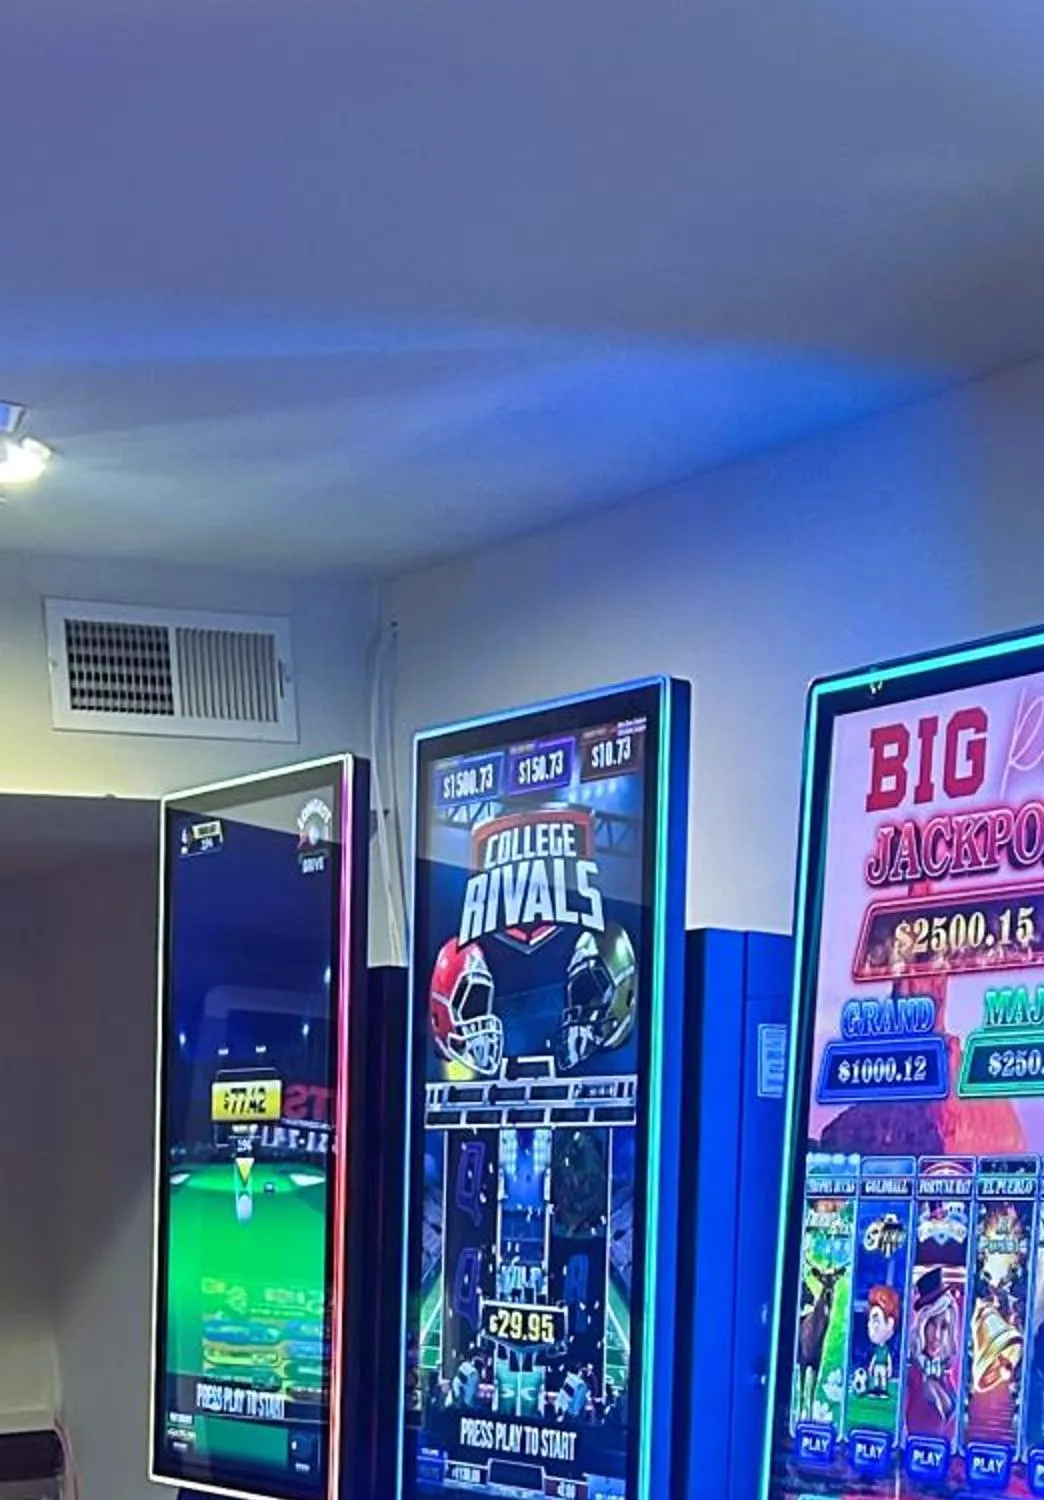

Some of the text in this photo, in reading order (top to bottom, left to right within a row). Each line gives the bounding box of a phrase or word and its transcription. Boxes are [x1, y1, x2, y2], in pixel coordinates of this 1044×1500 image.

[519, 750, 564, 785] $150.73
[591, 735, 632, 769] $10.73
[866, 706, 989, 812] BIG
[484, 822, 578, 869] COLLEGE
[458, 857, 606, 946] RIVALS
[893, 906, 1037, 957] $2500.15
[842, 998, 937, 1039] GRAND
[837, 1055, 928, 1086] $1000.12
[196, 1383, 223, 1413] PRESS
[223, 1386, 245, 1415] PLAY
[258, 1391, 286, 1420] START
[459, 1416, 578, 1462] PRESS PLAY TO START
[802, 1437, 829, 1453] PLAY
[855, 1443, 884, 1460] PLAY
[912, 1449, 943, 1467] PLAY
[973, 1457, 1004, 1473] PLAY
